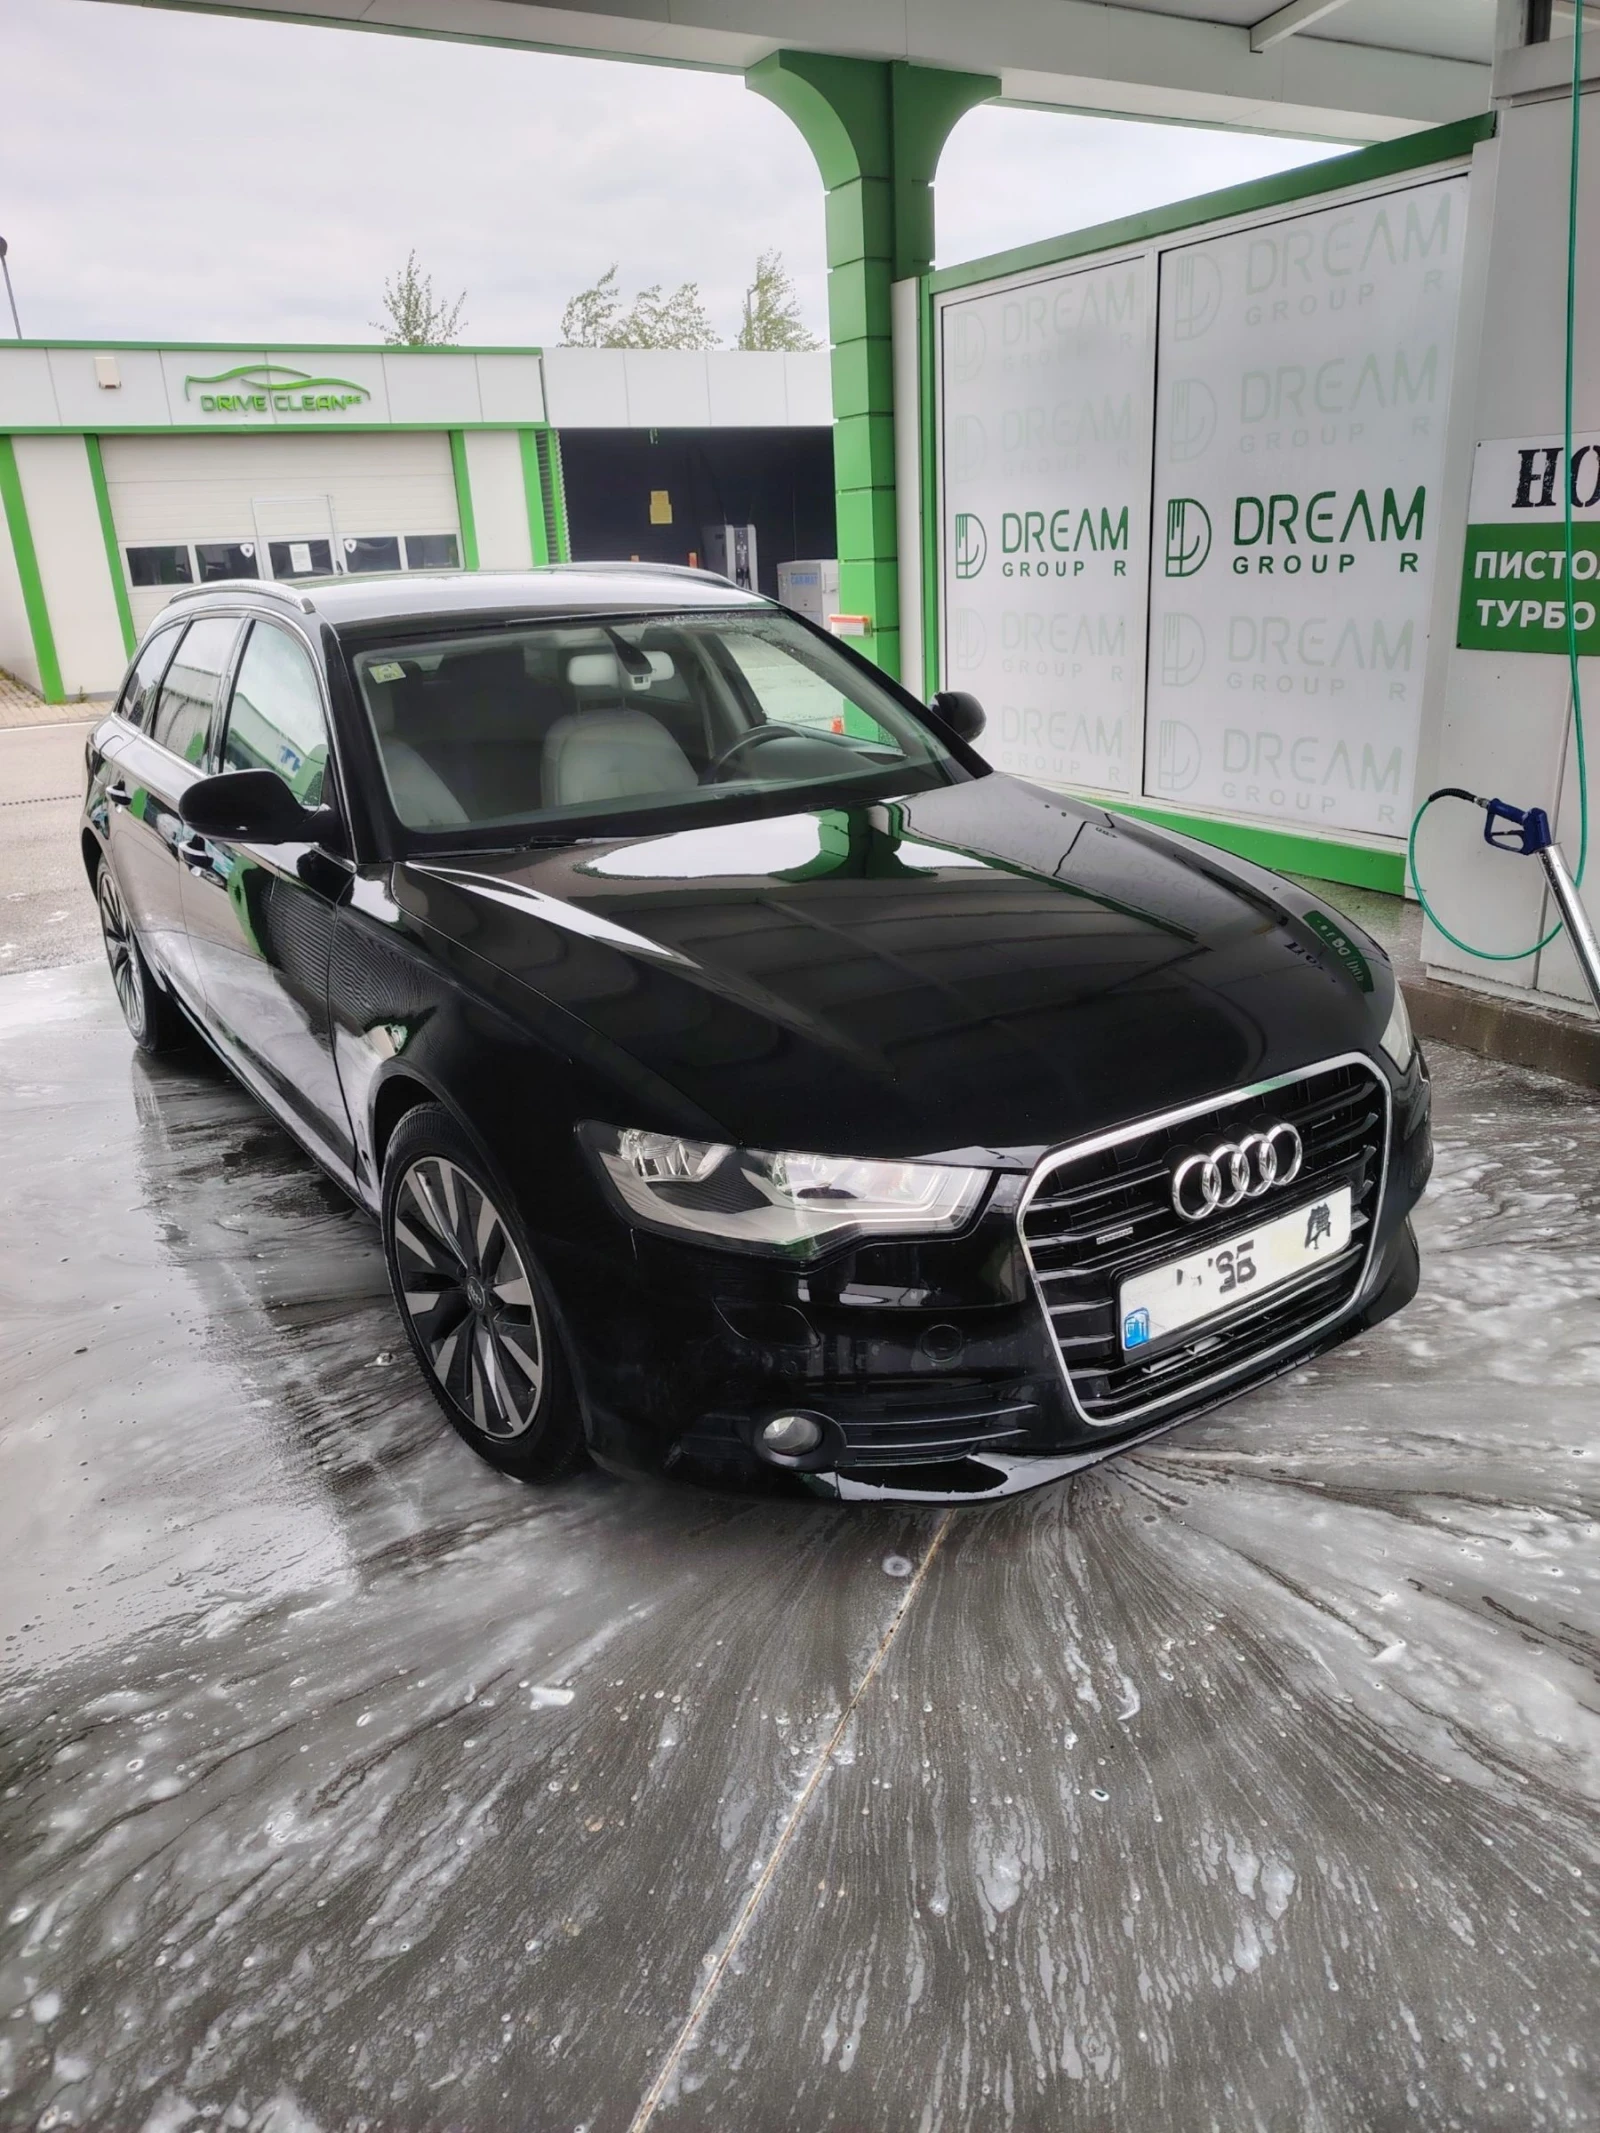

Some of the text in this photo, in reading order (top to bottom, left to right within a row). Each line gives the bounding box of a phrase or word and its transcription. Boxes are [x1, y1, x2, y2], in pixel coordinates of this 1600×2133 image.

[1245, 192, 1452, 296] DREAM
[1001, 272, 1135, 347] DREAM
[1245, 268, 1444, 327] GROUP R
[201, 394, 267, 412] DRIVE
[1240, 343, 1439, 425] DREAM
[1001, 393, 1132, 453] DREAM
[1239, 415, 1431, 454] GROUP R
[1002, 505, 1129, 554] DREAM
[1233, 485, 1427, 547] DREAM
[1002, 559, 1128, 578] GROUP R
[1232, 552, 1419, 576] GROUP R
[1474, 550, 1600, 580] ПИСТО
[1002, 610, 1126, 657] DREAM
[1476, 599, 1596, 632] ТУРБО
[1228, 615, 1415, 672] DREAM
[1001, 658, 1125, 683] GROUP R
[1226, 671, 1408, 703] GROUP R
[1001, 704, 1123, 760] DREAM
[1001, 751, 1121, 783] GROUP R
[1222, 728, 1404, 796] DREAM
[1220, 782, 1396, 824] GROUP R
